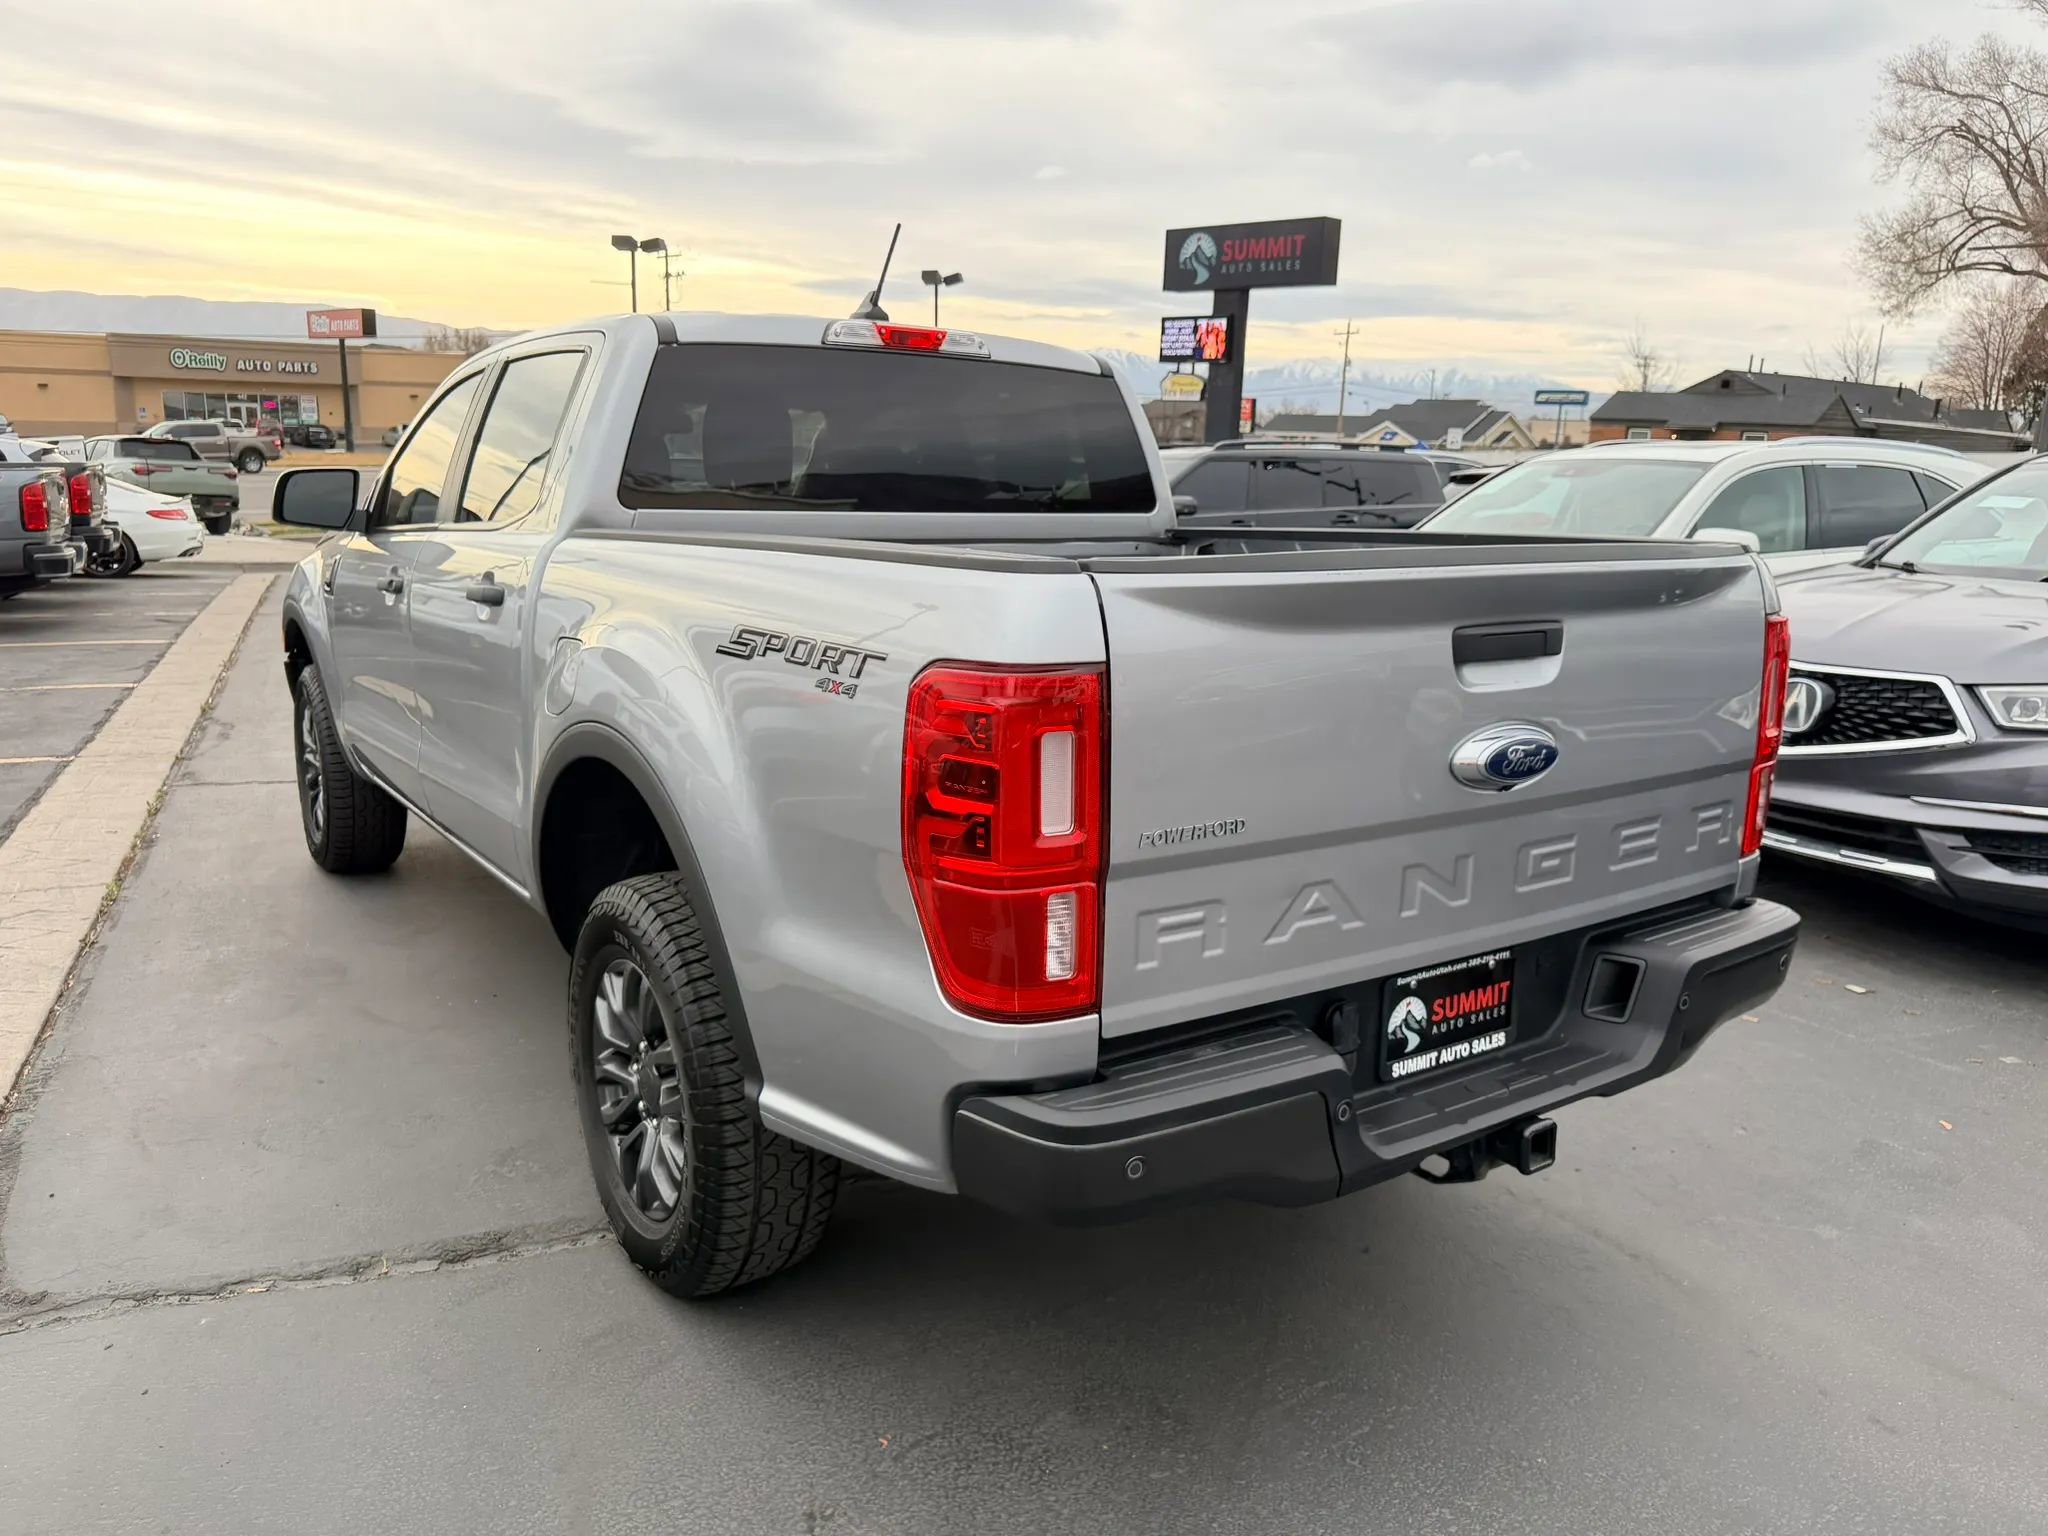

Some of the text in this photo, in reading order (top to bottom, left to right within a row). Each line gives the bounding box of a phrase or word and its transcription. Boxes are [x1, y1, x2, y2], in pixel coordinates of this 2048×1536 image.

[1221, 234, 1307, 262] SUMMIT
[1221, 260, 1301, 274] AUTO SALES
[170, 348, 319, 375] O'Reilly AUTO PARTS
[716, 624, 888, 679] SPORT
[1503, 744, 1547, 775] Ford
[1138, 818, 1246, 849] POWERFORD
[1136, 800, 1733, 972] RANGER
[1431, 981, 1511, 1022] SUMMIT
[1431, 1005, 1506, 1035] AUTO SALES
[1392, 1032, 1507, 1078] SUMMIT AUTO SALES
